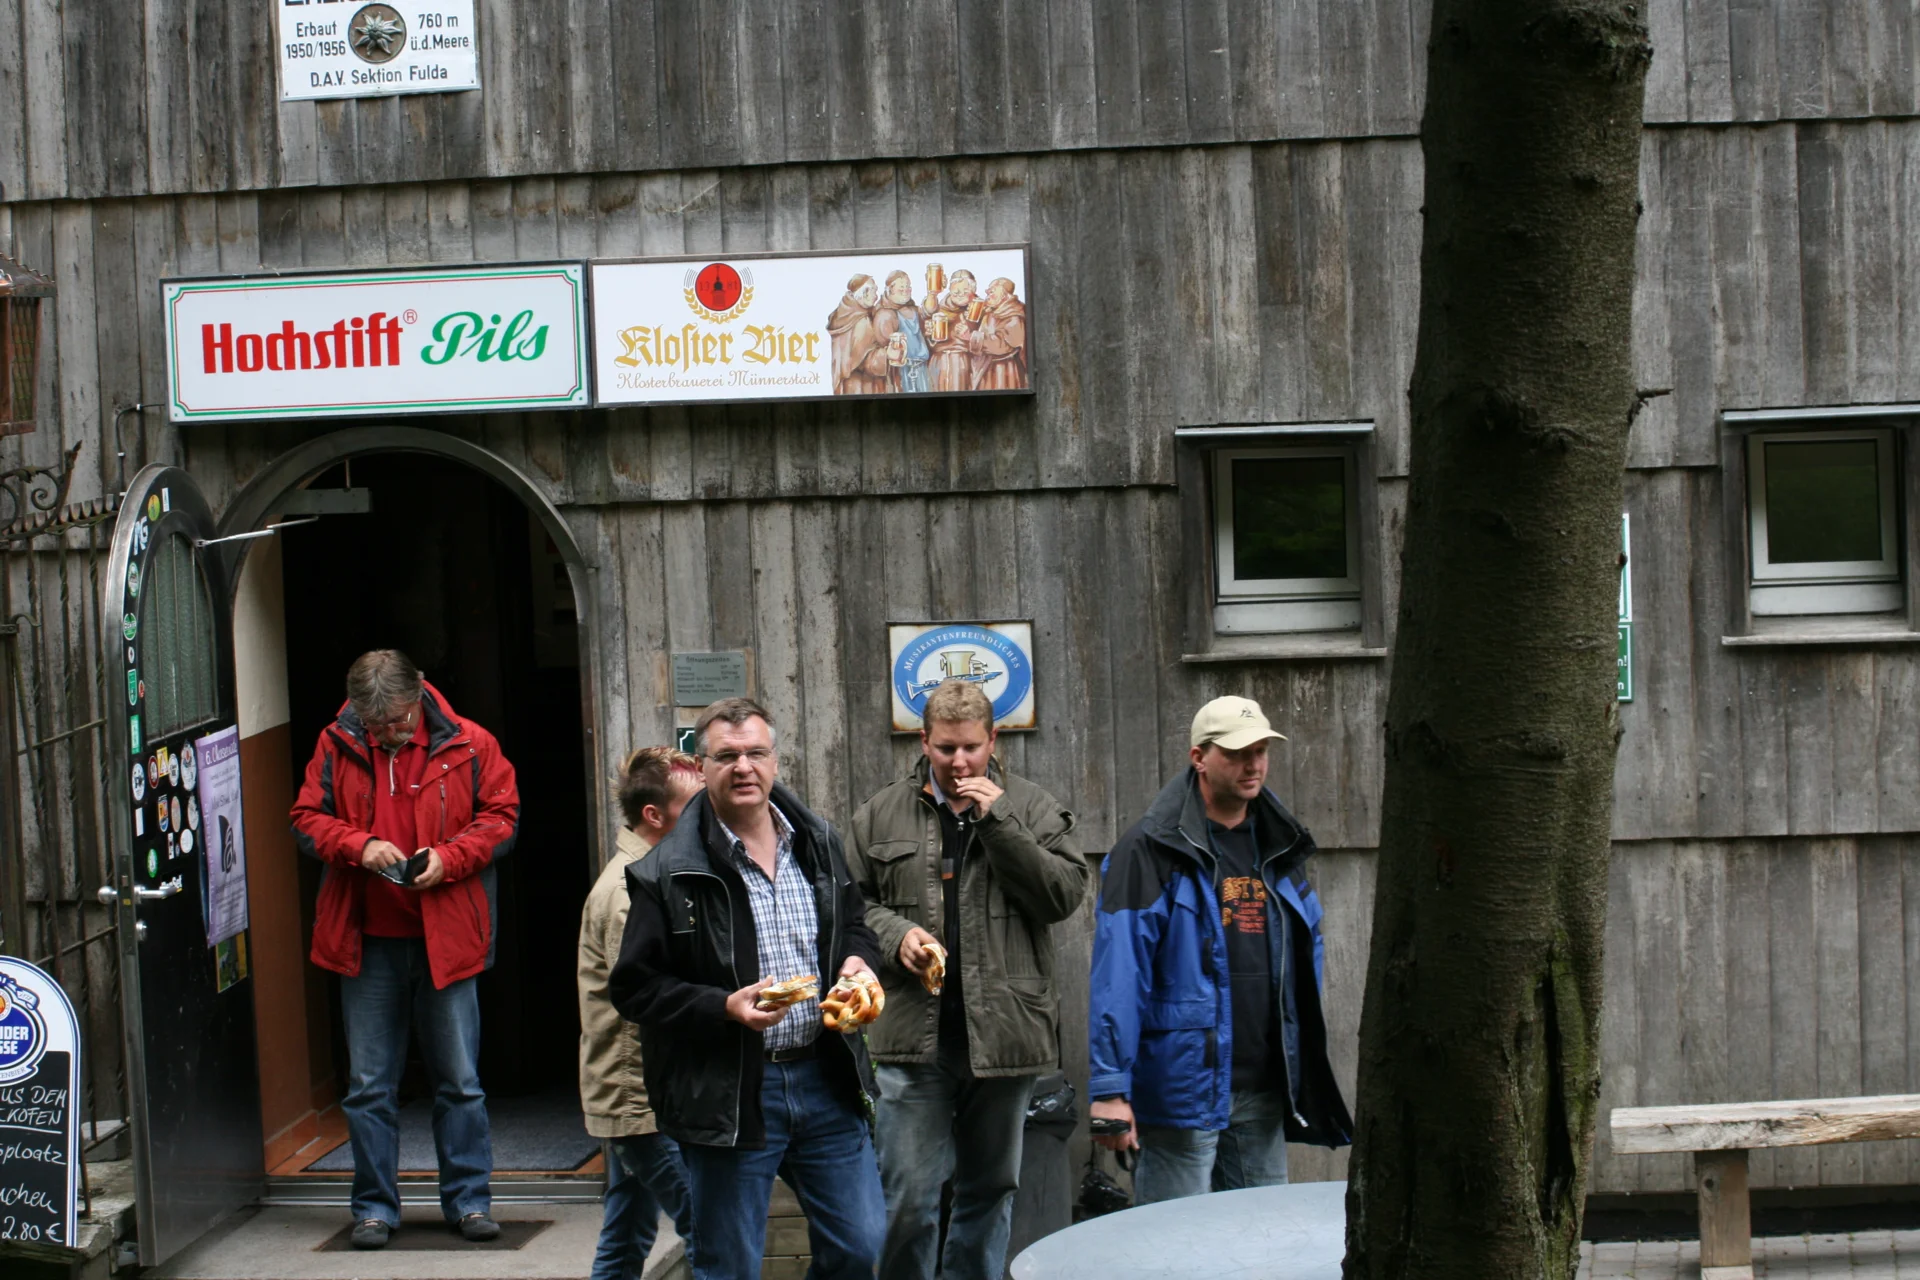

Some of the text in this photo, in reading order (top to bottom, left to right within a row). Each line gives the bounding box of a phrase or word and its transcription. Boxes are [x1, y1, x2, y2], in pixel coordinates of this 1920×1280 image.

[296, 21, 337, 38] Erbaut
[418, 13, 459, 29] 760 m
[286, 41, 346, 59] 1950/1956
[410, 33, 469, 50] ü.d.Meere
[310, 64, 448, 88] D.A.V. Sektion Fulda
[420, 309, 550, 365] Pils
[741, 324, 821, 367] Bier
[616, 369, 821, 390] Klosterbrauerei Münnerstadt
[0, 1066, 26, 1079] ENBIER
[2, 1216, 41, 1241] 2.80
